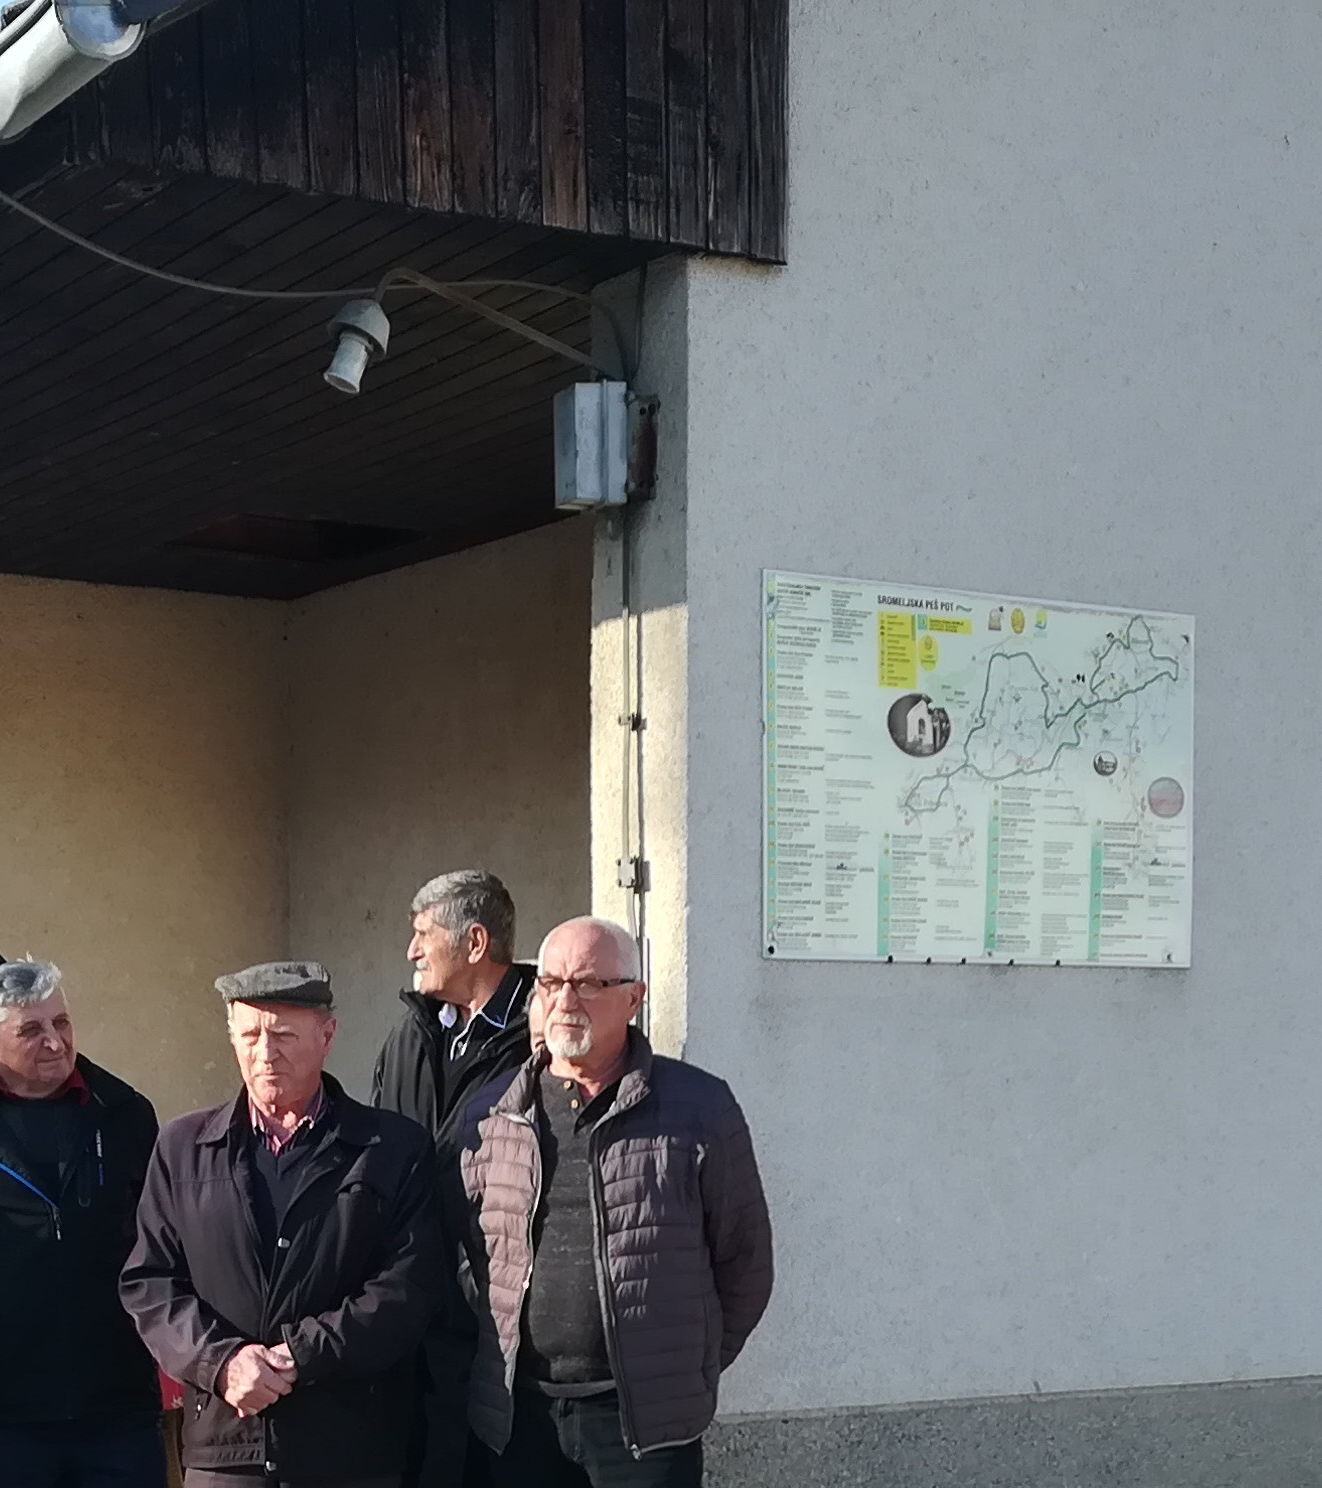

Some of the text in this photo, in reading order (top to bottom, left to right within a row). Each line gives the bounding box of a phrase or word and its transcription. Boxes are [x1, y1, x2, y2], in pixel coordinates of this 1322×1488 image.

[877, 595, 953, 611] SROMELJSKA PEŠ POT
